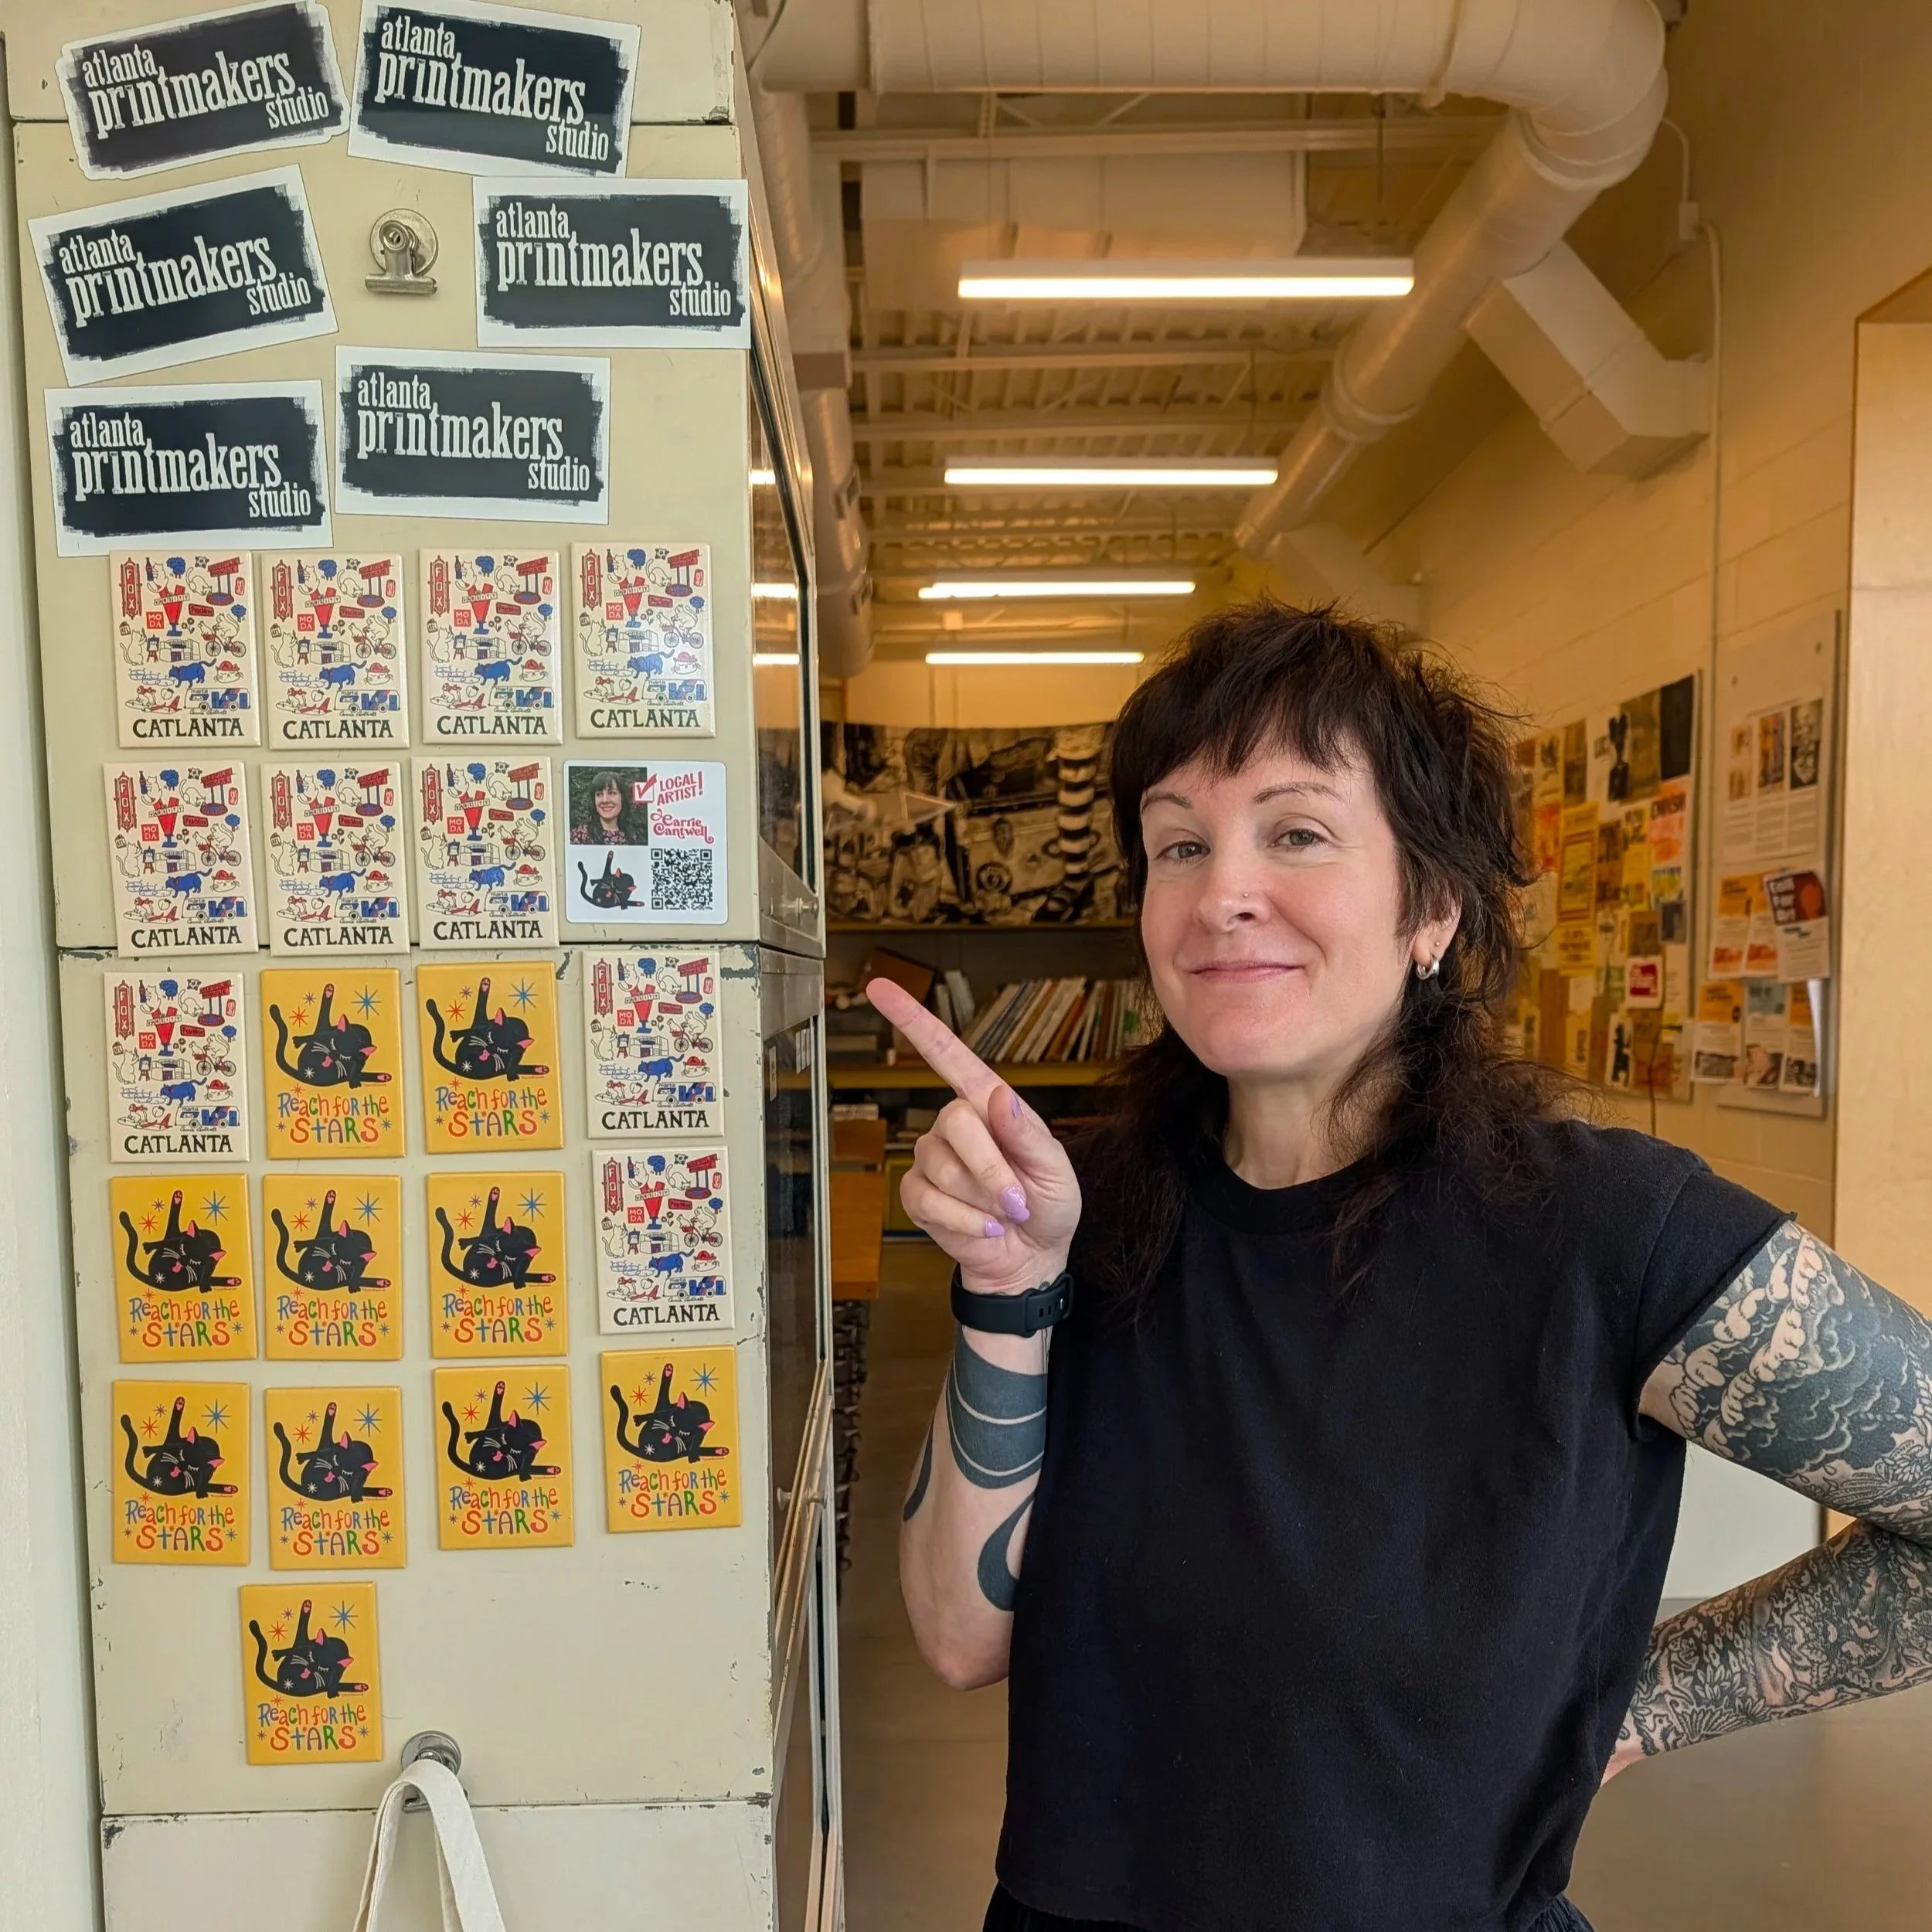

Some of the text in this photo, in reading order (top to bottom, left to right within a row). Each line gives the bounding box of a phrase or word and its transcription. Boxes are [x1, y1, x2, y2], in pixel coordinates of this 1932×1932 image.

[380, 15, 454, 59] atlanta
[82, 43, 157, 90] atlanta
[89, 51, 294, 139] printmakers
[374, 51, 586, 126] printmakers
[266, 87, 330, 131] studio
[545, 121, 610, 162] studio
[495, 202, 570, 239] atlanta
[59, 228, 134, 274] atlanta
[496, 228, 703, 291] printmakers
[65, 234, 277, 328] printmakers
[247, 272, 312, 317] studio
[669, 281, 732, 318] studio
[357, 372, 433, 410] atlanta
[70, 410, 145, 448] atlanta
[357, 403, 564, 463] printmakers
[73, 432, 283, 501] printmakers
[528, 456, 590, 492] studio
[249, 483, 311, 519] studio
[126, 569, 134, 609] FOX
[277, 571, 286, 611] FOX
[132, 717, 244, 737] CATLANTA
[282, 719, 394, 739] CATLANTA
[437, 715, 548, 734] CATLANTA
[590, 709, 701, 728] CATLANTA
[427, 775, 436, 814] FOX
[659, 773, 697, 791] LOCAL
[120, 783, 130, 821] FOX
[277, 781, 285, 821] FOX
[651, 808, 702, 827] Carrie
[653, 822, 714, 844] Cantwell
[131, 925, 243, 948] CATLANTA
[284, 926, 394, 947] CATLANTA
[433, 920, 543, 940] CATLANTA
[277, 1092, 329, 1117] Reach
[362, 1094, 389, 1117] the
[434, 1085, 488, 1111] Reach
[519, 1086, 547, 1110] the
[601, 1110, 709, 1130] CATLANTA
[124, 1134, 233, 1154] CATLANTA
[128, 1297, 181, 1322] Reach
[212, 1298, 240, 1321] the
[276, 1294, 328, 1321] Reach
[360, 1298, 388, 1322] the
[441, 1293, 494, 1318] Reach
[526, 1294, 553, 1318] the
[613, 1303, 720, 1325] CATLANTA
[617, 1467, 669, 1494] Reach
[700, 1466, 727, 1491] the
[124, 1499, 176, 1526] Reach
[207, 1504, 235, 1528] the
[449, 1485, 500, 1510] Reach
[531, 1485, 559, 1509] the
[280, 1506, 332, 1531] Reach
[362, 1508, 390, 1531] the
[257, 1702, 308, 1727] Reach
[339, 1702, 366, 1726] the
